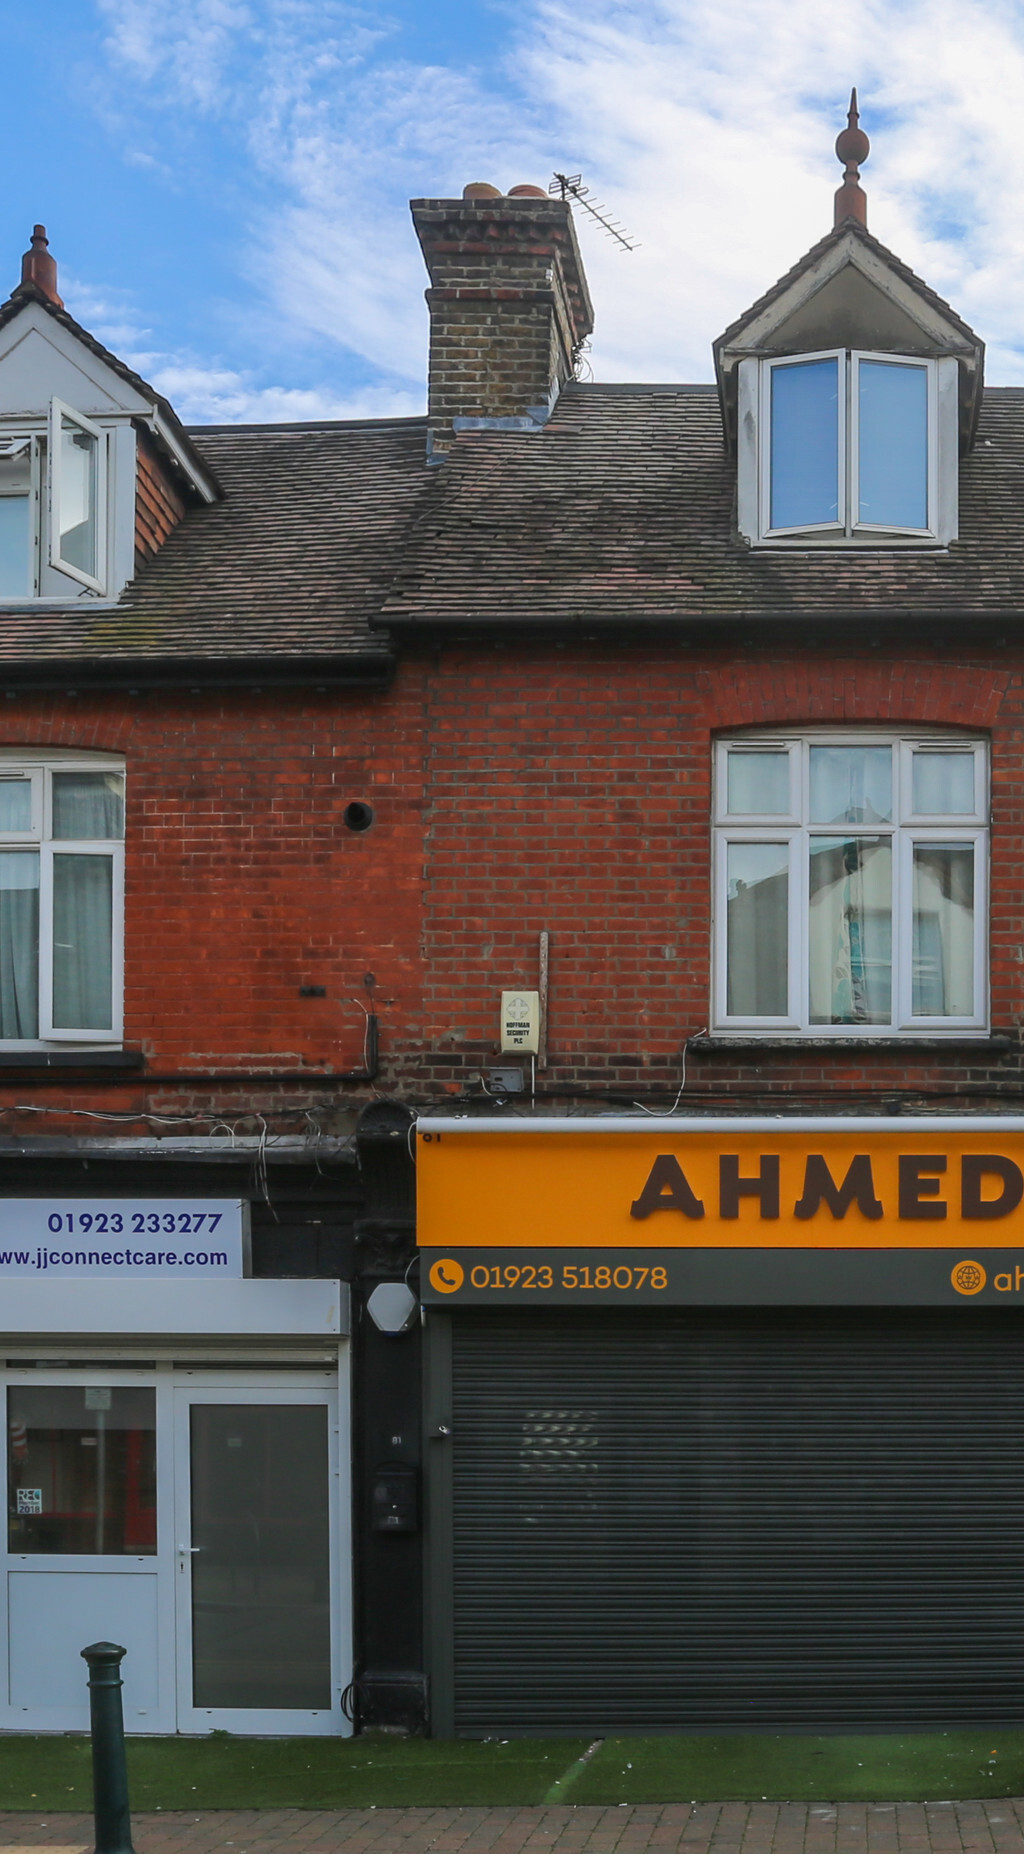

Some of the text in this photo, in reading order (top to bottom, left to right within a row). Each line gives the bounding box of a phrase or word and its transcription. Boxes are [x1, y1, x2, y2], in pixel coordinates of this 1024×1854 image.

[629, 1154, 1024, 1219] AHMED
[48, 1213, 223, 1233] 01923 233277
[470, 1265, 668, 1290] 01923 518078
[392, 1436, 402, 1445] 81
